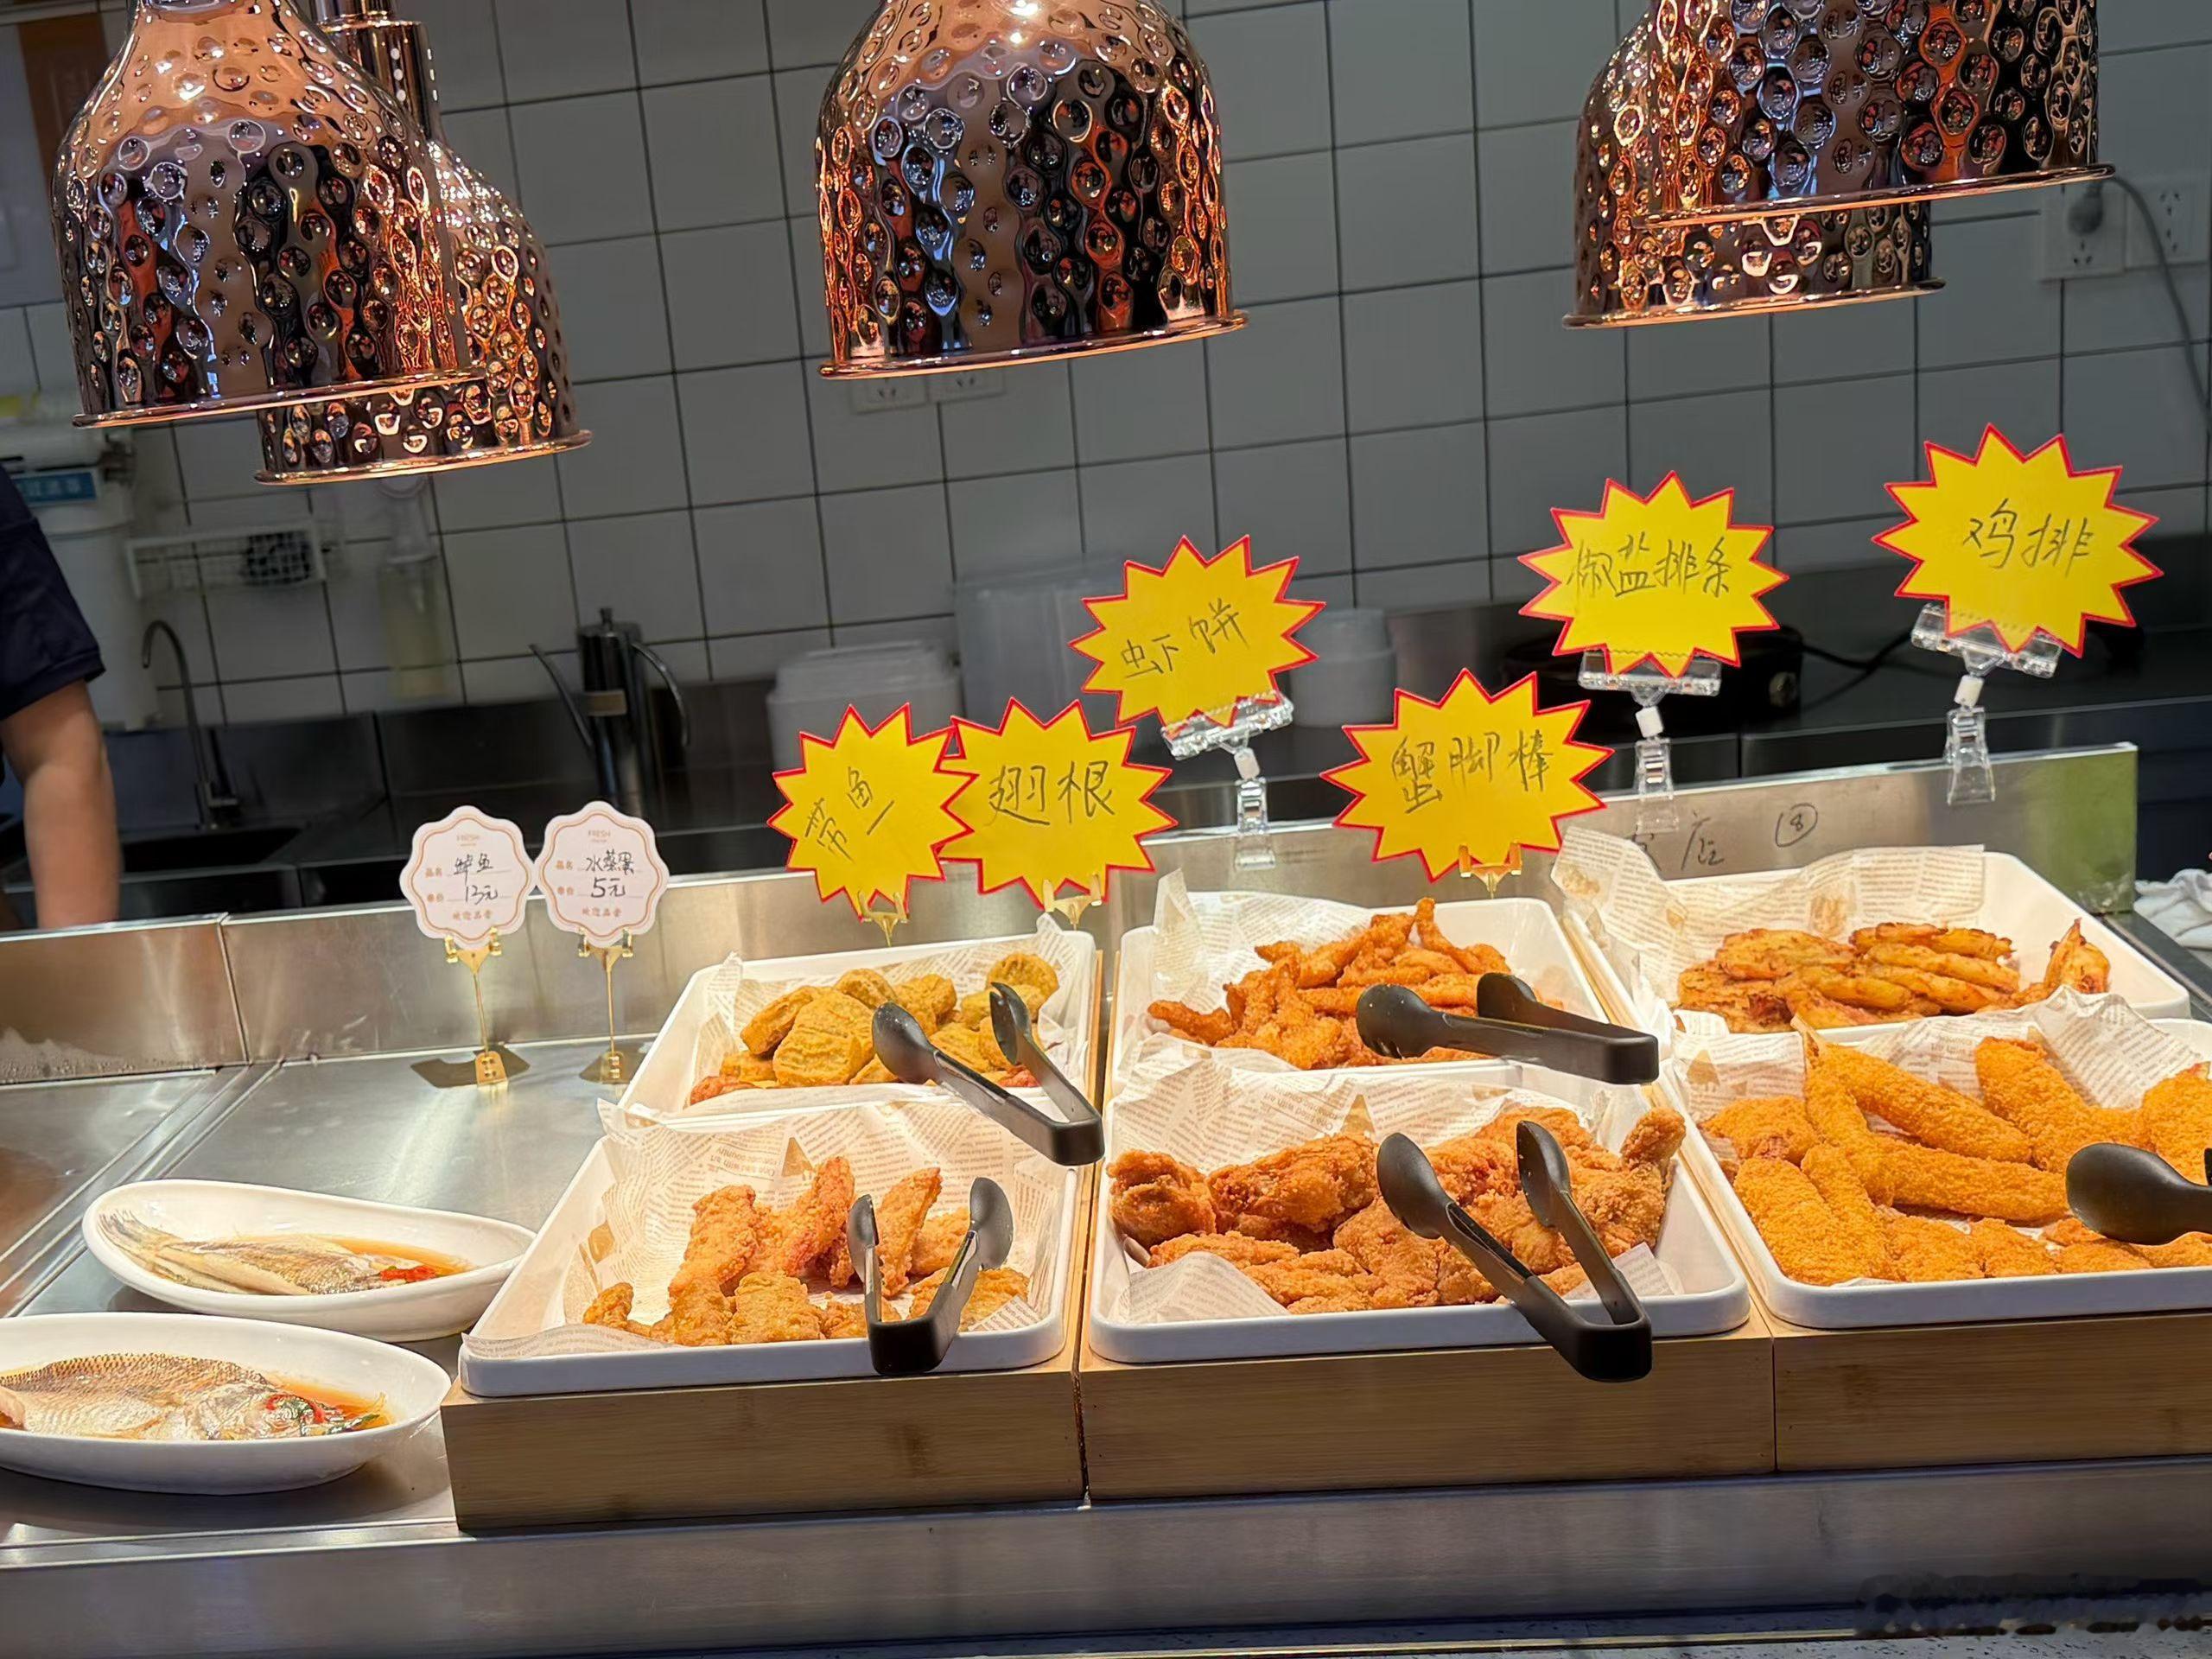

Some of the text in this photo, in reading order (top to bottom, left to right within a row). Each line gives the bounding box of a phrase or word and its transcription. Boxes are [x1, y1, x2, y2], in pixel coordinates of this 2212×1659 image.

[1566, 531, 1732, 598] 椒盐排条
[1962, 497, 2094, 579] 鸡排
[1120, 597, 1251, 679] 虾饼
[983, 760, 1116, 827] 翅根
[1391, 728, 1554, 814] 蟹脚棒
[804, 766, 895, 863] 带鱼
[590, 876, 626, 899] 5元
